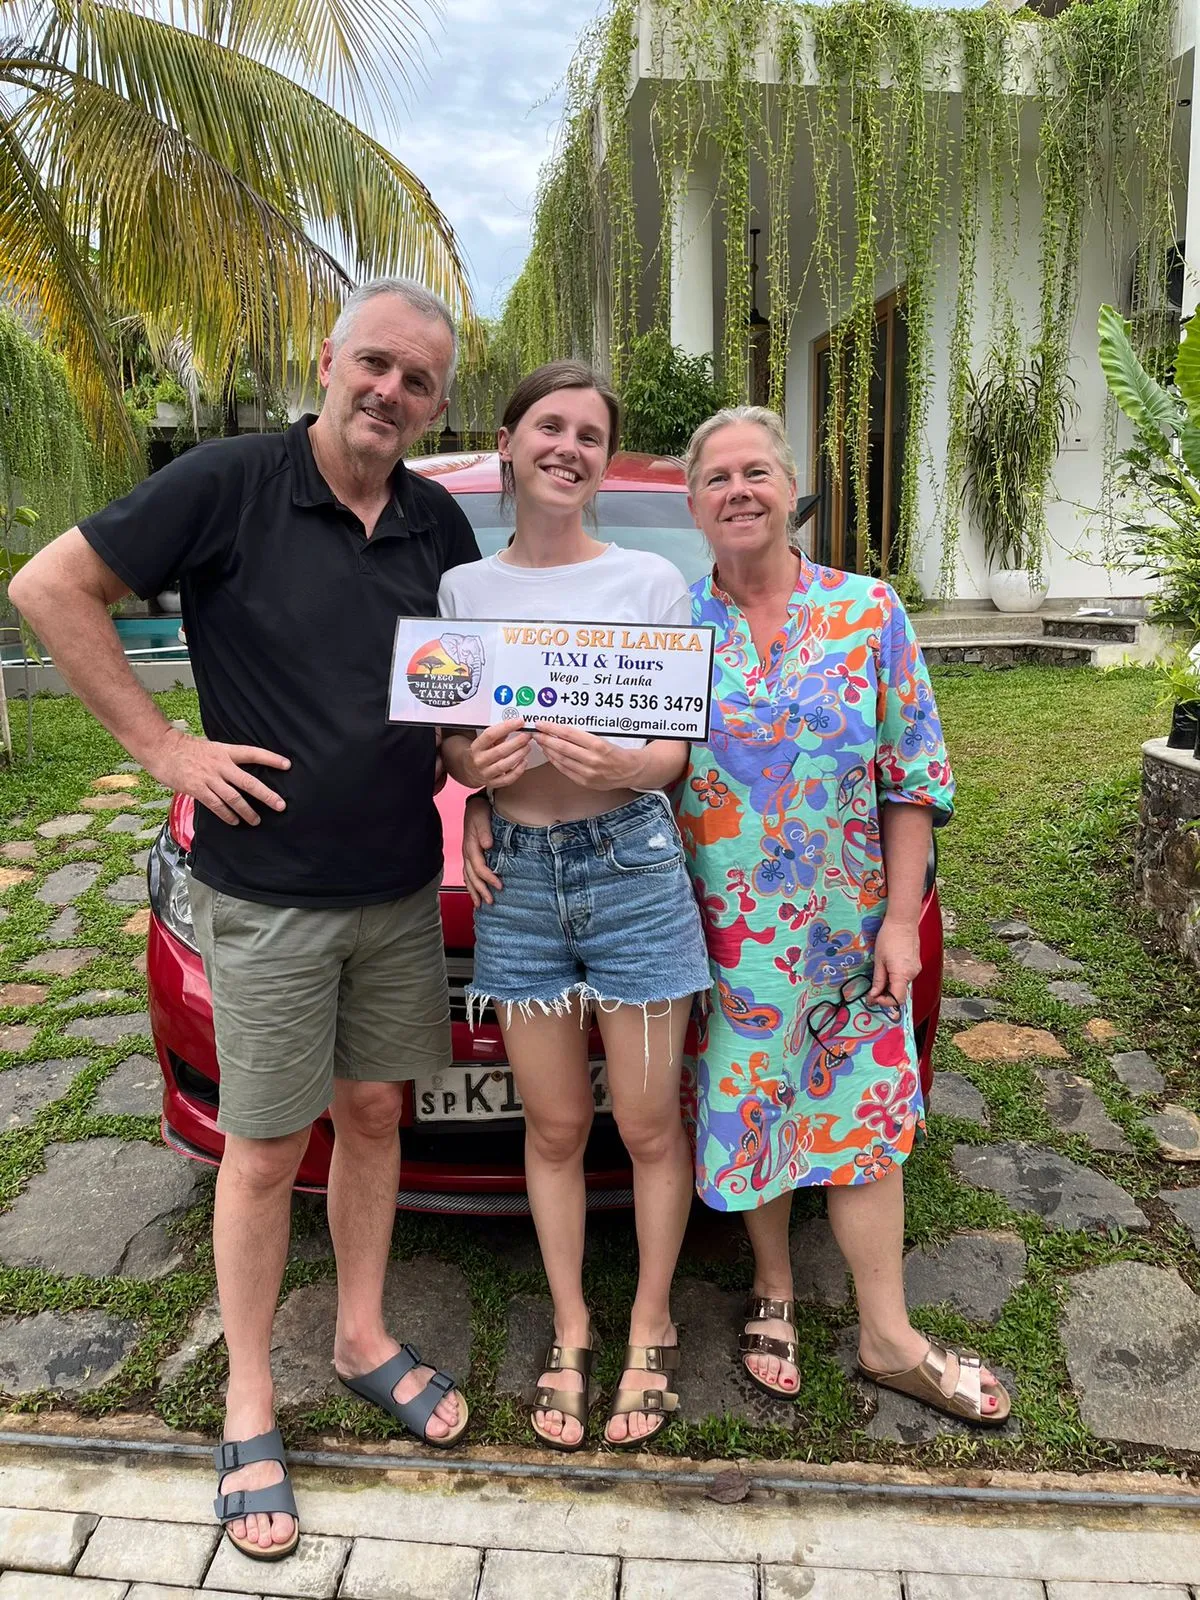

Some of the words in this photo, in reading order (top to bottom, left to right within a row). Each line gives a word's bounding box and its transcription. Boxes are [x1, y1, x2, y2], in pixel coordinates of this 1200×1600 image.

[502, 626, 569, 646] WEGO
[575, 628, 615, 648] SRI
[621, 630, 704, 652] LANKA
[541, 651, 588, 668] TAXI
[593, 653, 608, 669] &
[614, 654, 664, 671] Tours
[415, 681, 430, 689] SRI
[431, 682, 459, 690] LANKA
[549, 671, 579, 685] Wego
[594, 673, 611, 685] Sri
[615, 674, 652, 686] Lanka
[419, 689, 446, 699] TAXI
[560, 690, 589, 707] +39
[594, 692, 624, 708] 345
[629, 694, 659, 710] 536
[663, 695, 704, 712] 3479
[421, 1091, 456, 1114] SP
